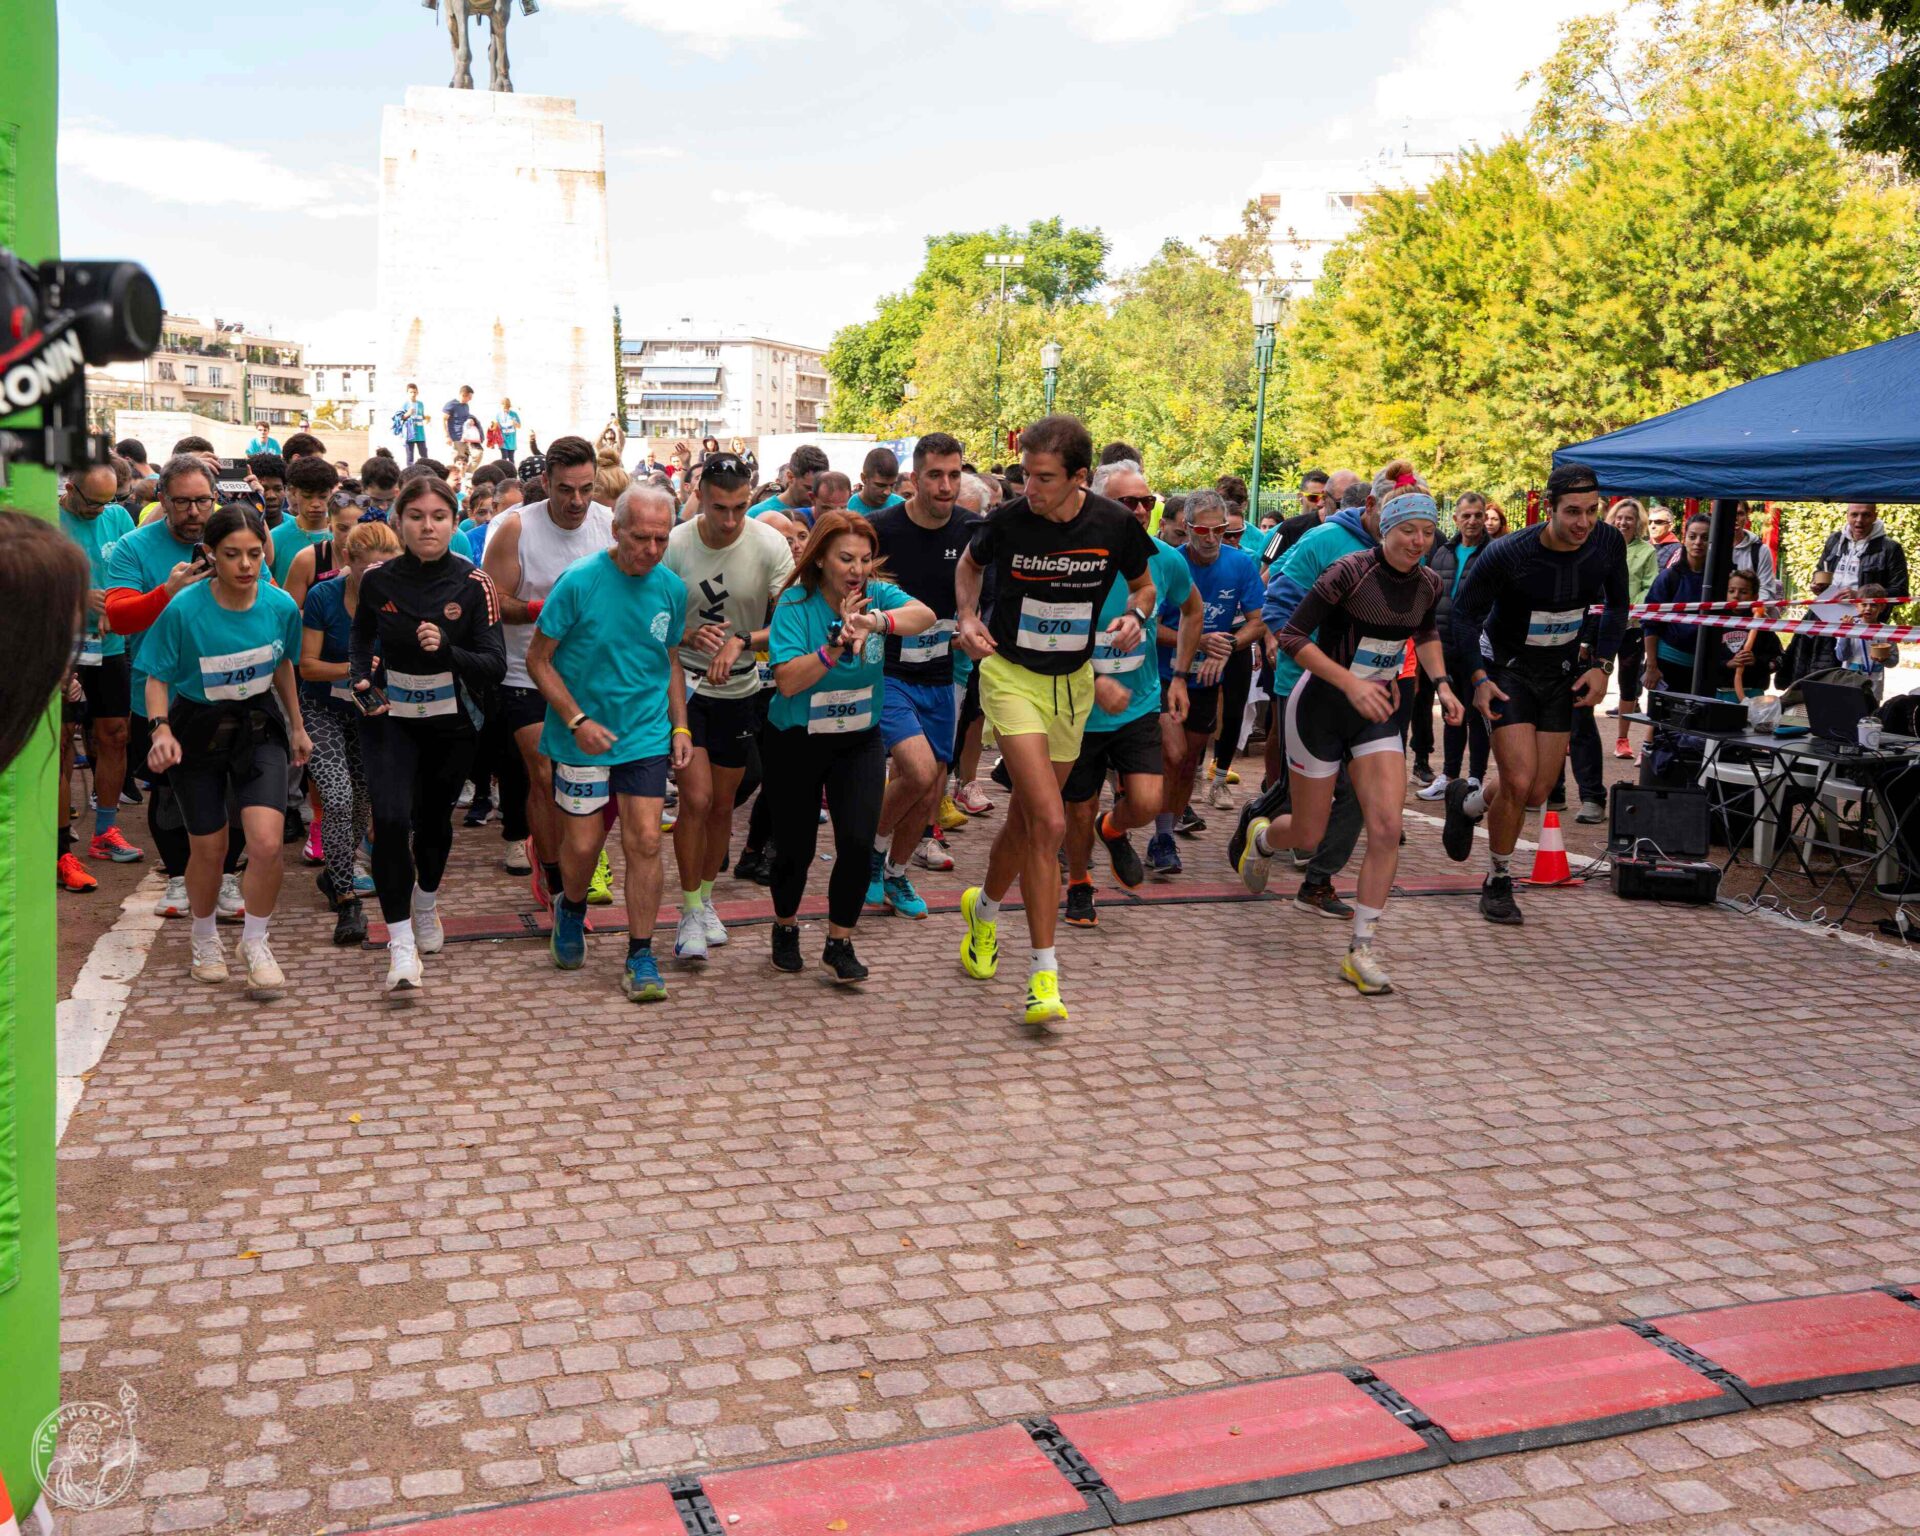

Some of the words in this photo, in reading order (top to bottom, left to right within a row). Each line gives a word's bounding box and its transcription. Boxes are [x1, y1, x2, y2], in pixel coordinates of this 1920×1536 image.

[1011, 553, 1108, 576] EthicSport
[1037, 620, 1072, 634] 670
[1543, 623, 1570, 634] 474
[917, 634, 939, 648] 548
[222, 666, 256, 685] 749
[403, 690, 436, 703] 795
[826, 703, 857, 717] 596
[565, 782, 593, 797] 753
